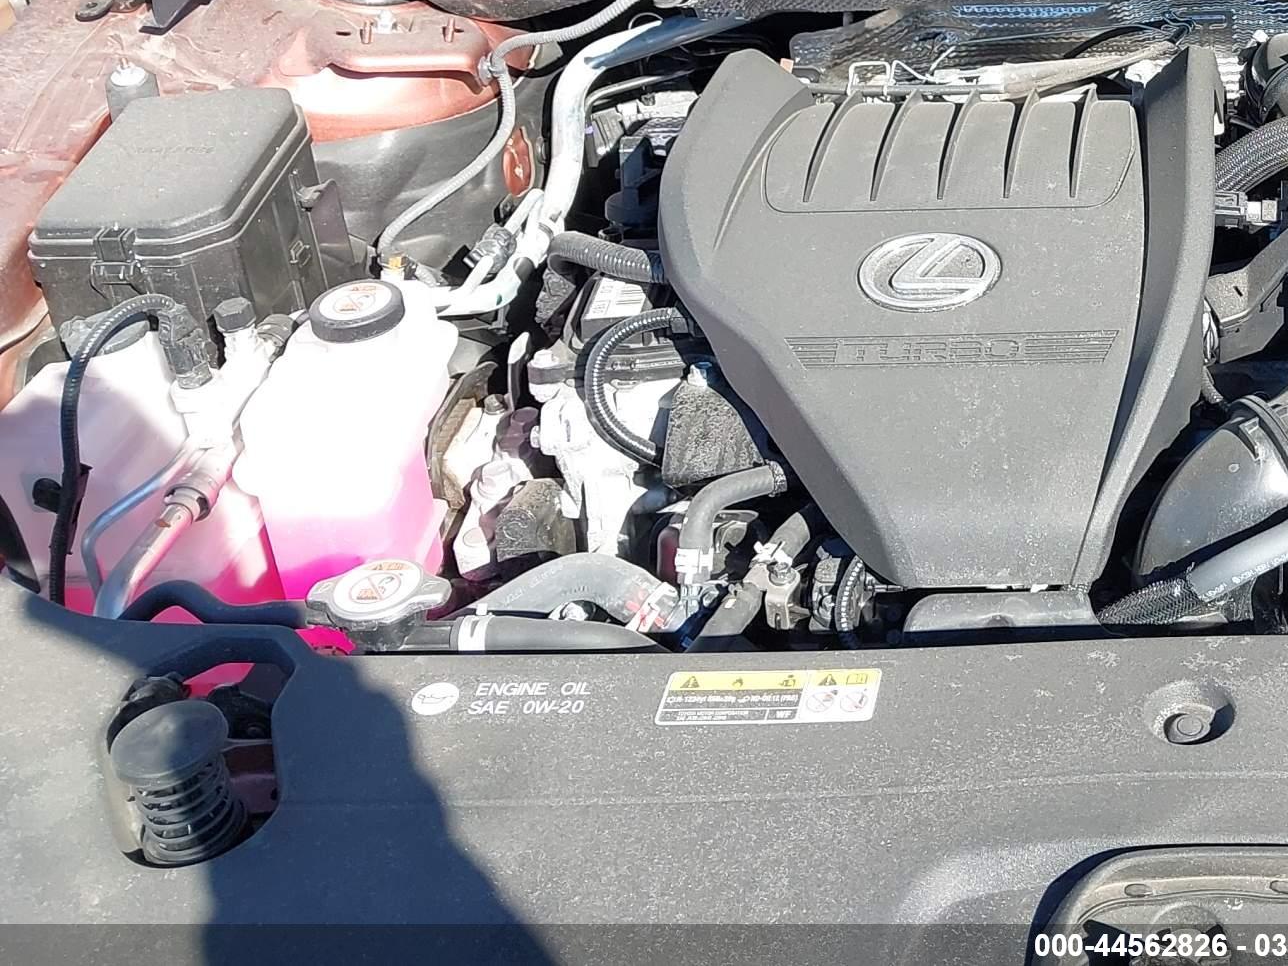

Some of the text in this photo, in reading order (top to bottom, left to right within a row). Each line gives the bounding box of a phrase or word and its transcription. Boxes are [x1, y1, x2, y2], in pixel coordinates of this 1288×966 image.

[843, 339, 1019, 362] TURBO
[475, 682, 591, 696] ENGINE OIL
[467, 700, 585, 715] SAE 0W-20
